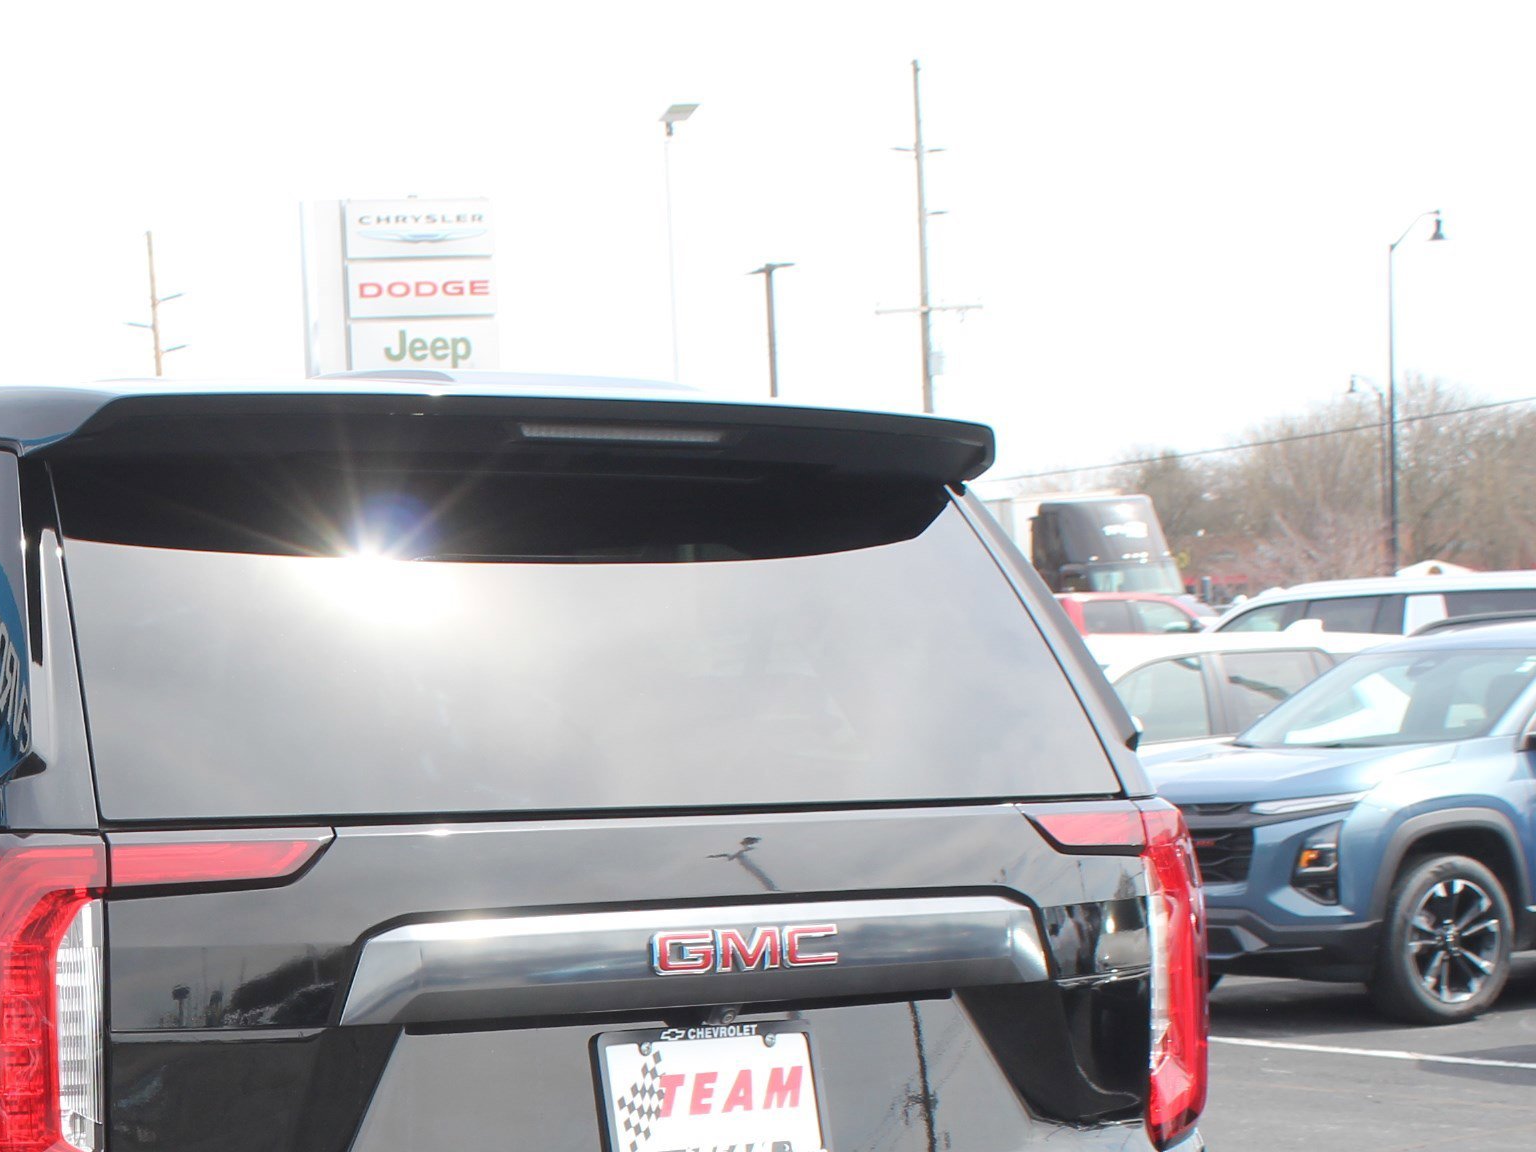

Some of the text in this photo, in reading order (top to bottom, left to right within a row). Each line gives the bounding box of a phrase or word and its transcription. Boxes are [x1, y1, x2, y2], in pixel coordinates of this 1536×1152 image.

[358, 213, 485, 225] CHRYSLER
[358, 280, 490, 299] DODGE
[383, 329, 472, 369] Jeep
[648, 924, 839, 976] GMC
[687, 1023, 758, 1040] CHEVROLET
[658, 1065, 804, 1118] TEAM
